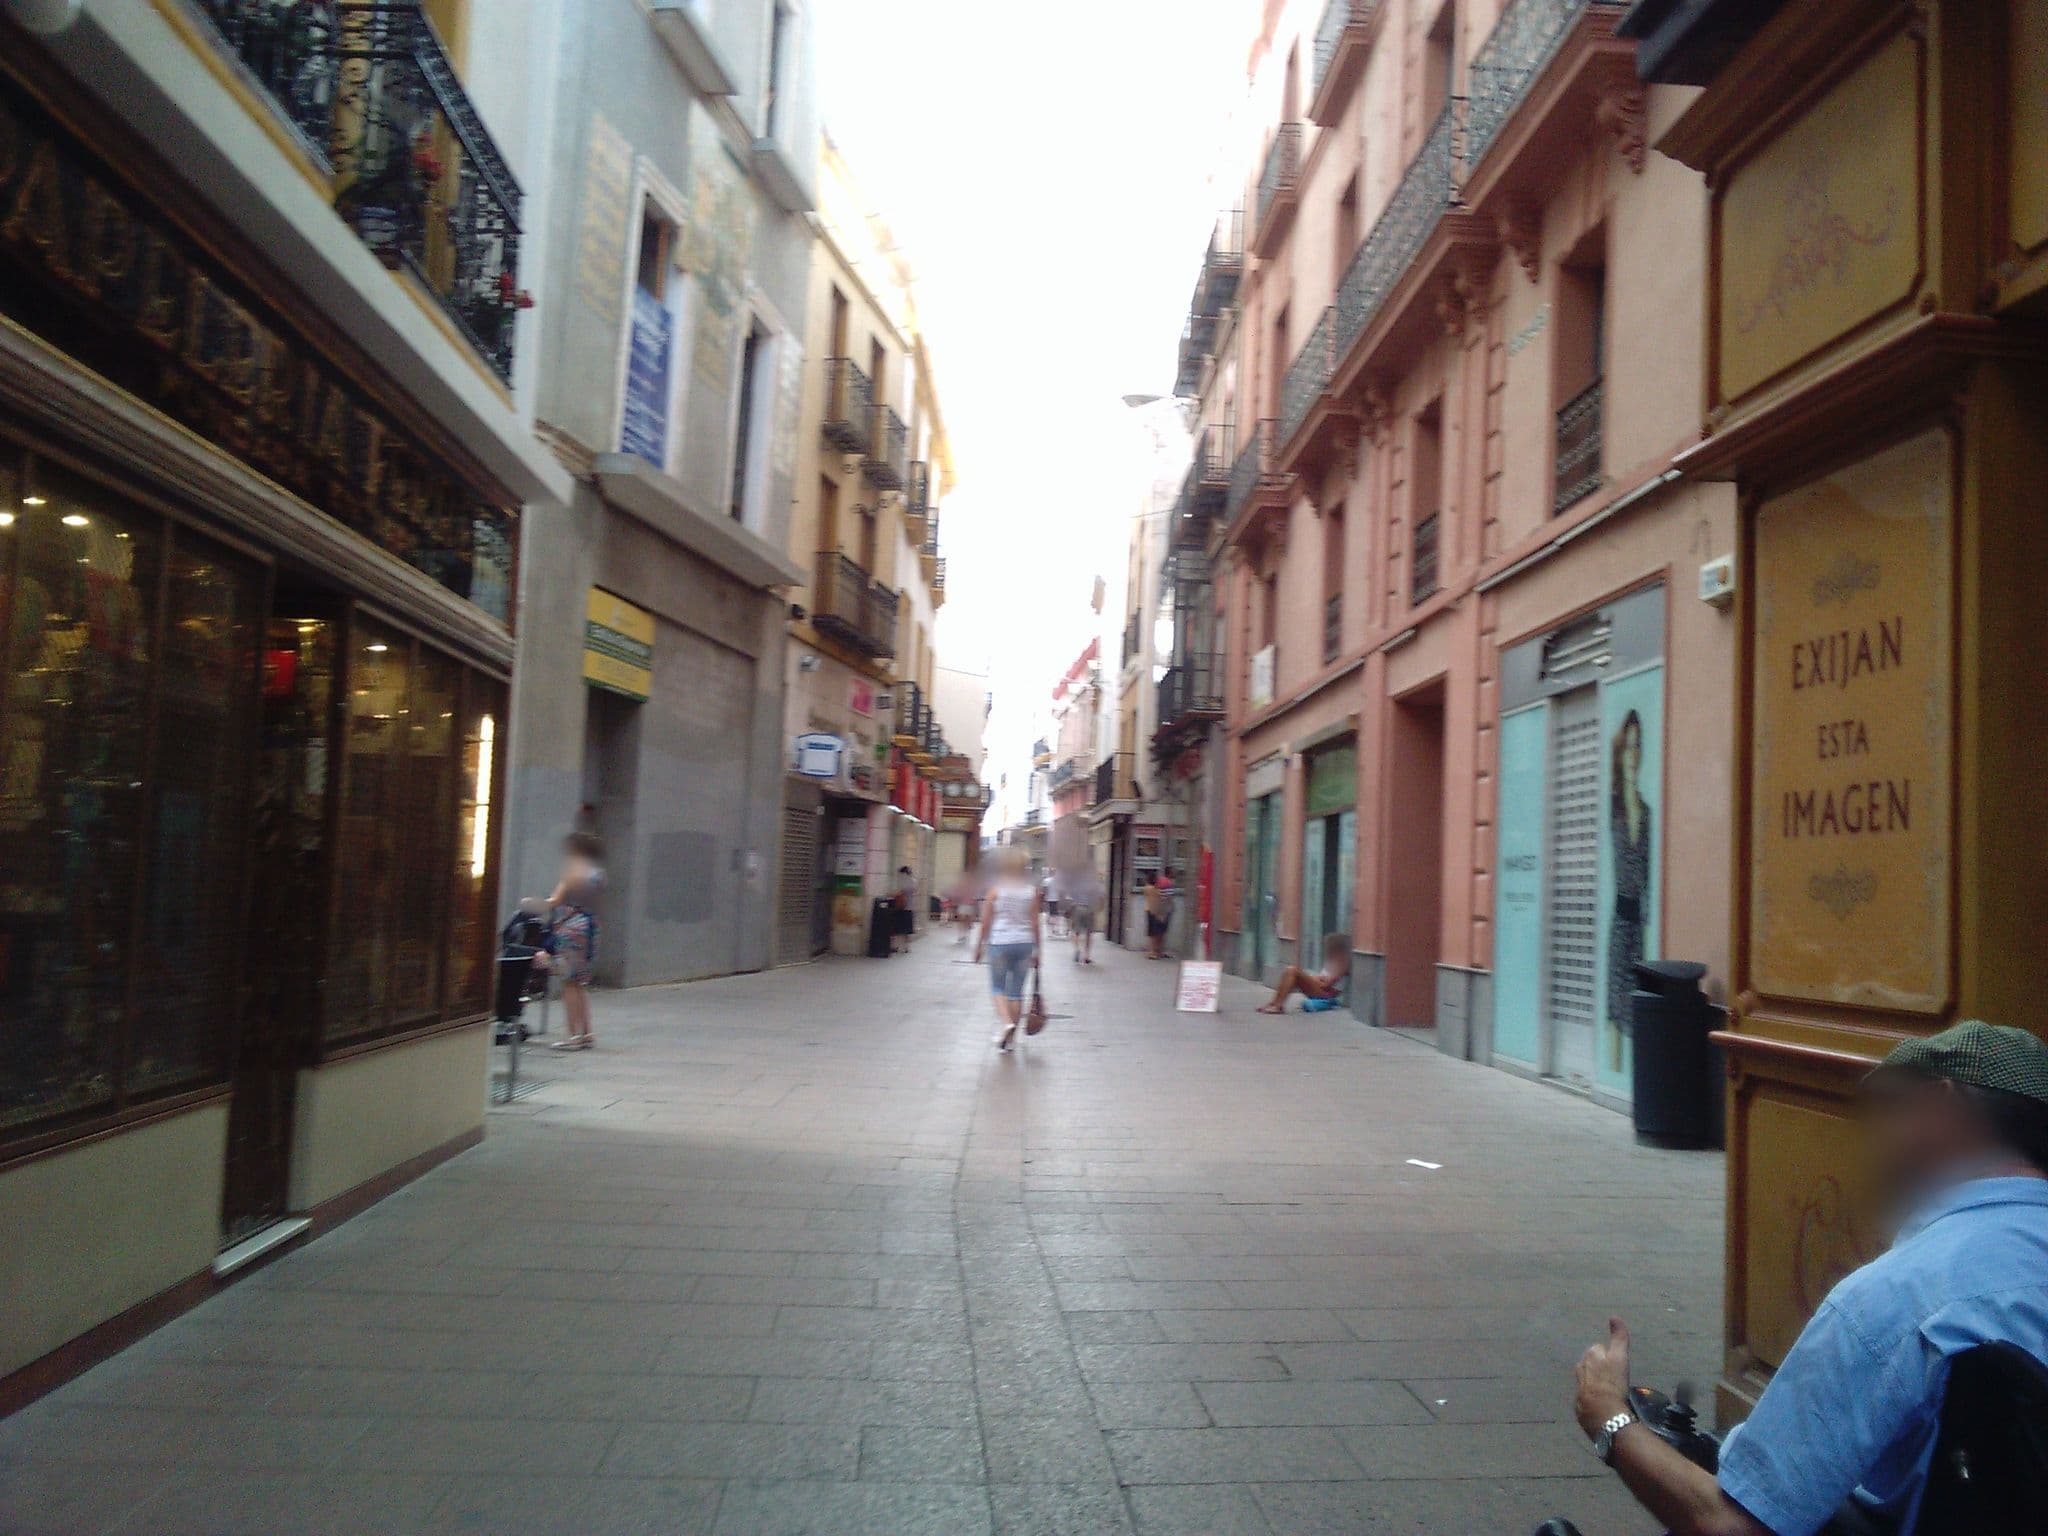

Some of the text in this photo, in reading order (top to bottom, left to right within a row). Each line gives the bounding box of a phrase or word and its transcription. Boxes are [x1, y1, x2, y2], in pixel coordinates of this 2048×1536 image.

[1791, 615, 1903, 690] EXIJAN
[1817, 720, 1870, 760] ESTA
[1783, 779, 1911, 838] IMAGEN
